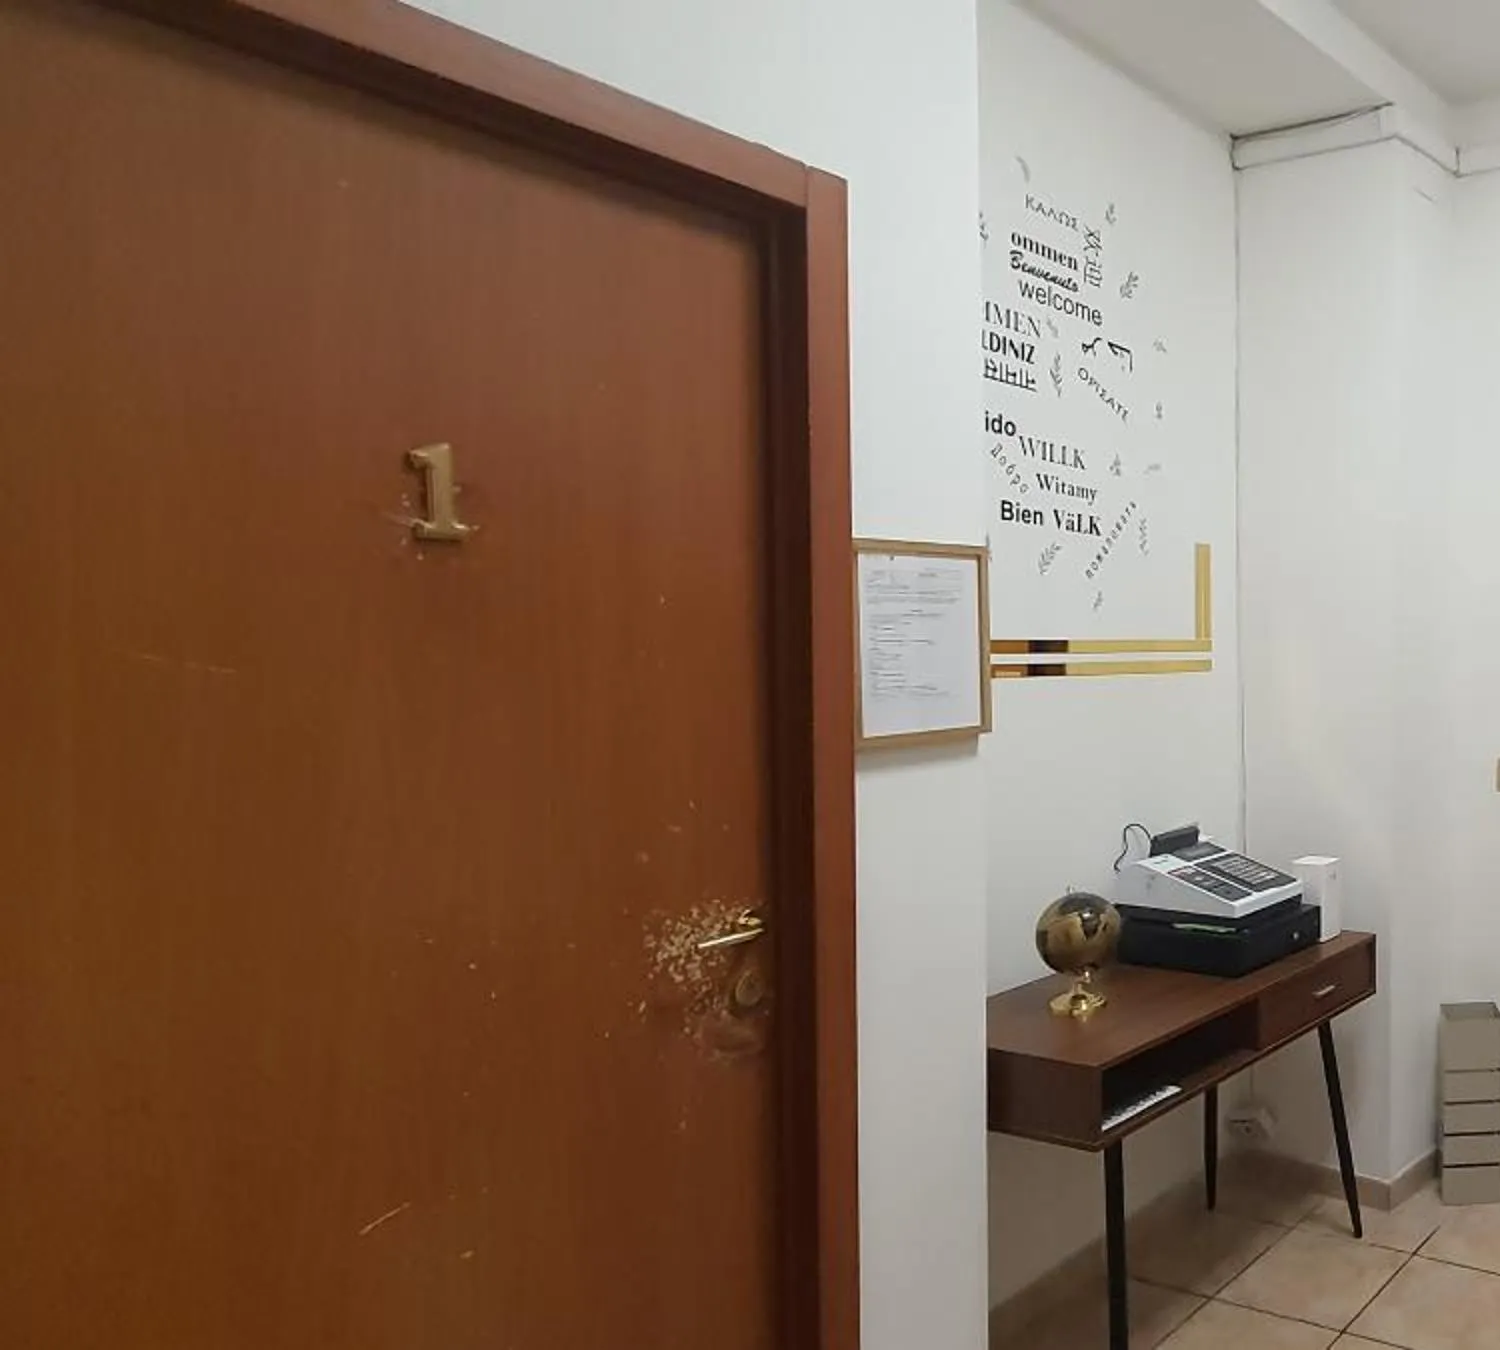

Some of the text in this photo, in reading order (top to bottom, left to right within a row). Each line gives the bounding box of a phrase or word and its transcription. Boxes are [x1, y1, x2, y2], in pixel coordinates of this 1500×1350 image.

[1018, 279, 1103, 327] welcome
[404, 442, 470, 541] 1
[1036, 473, 1098, 506] Witamy
[1001, 499, 1044, 526] Bien
